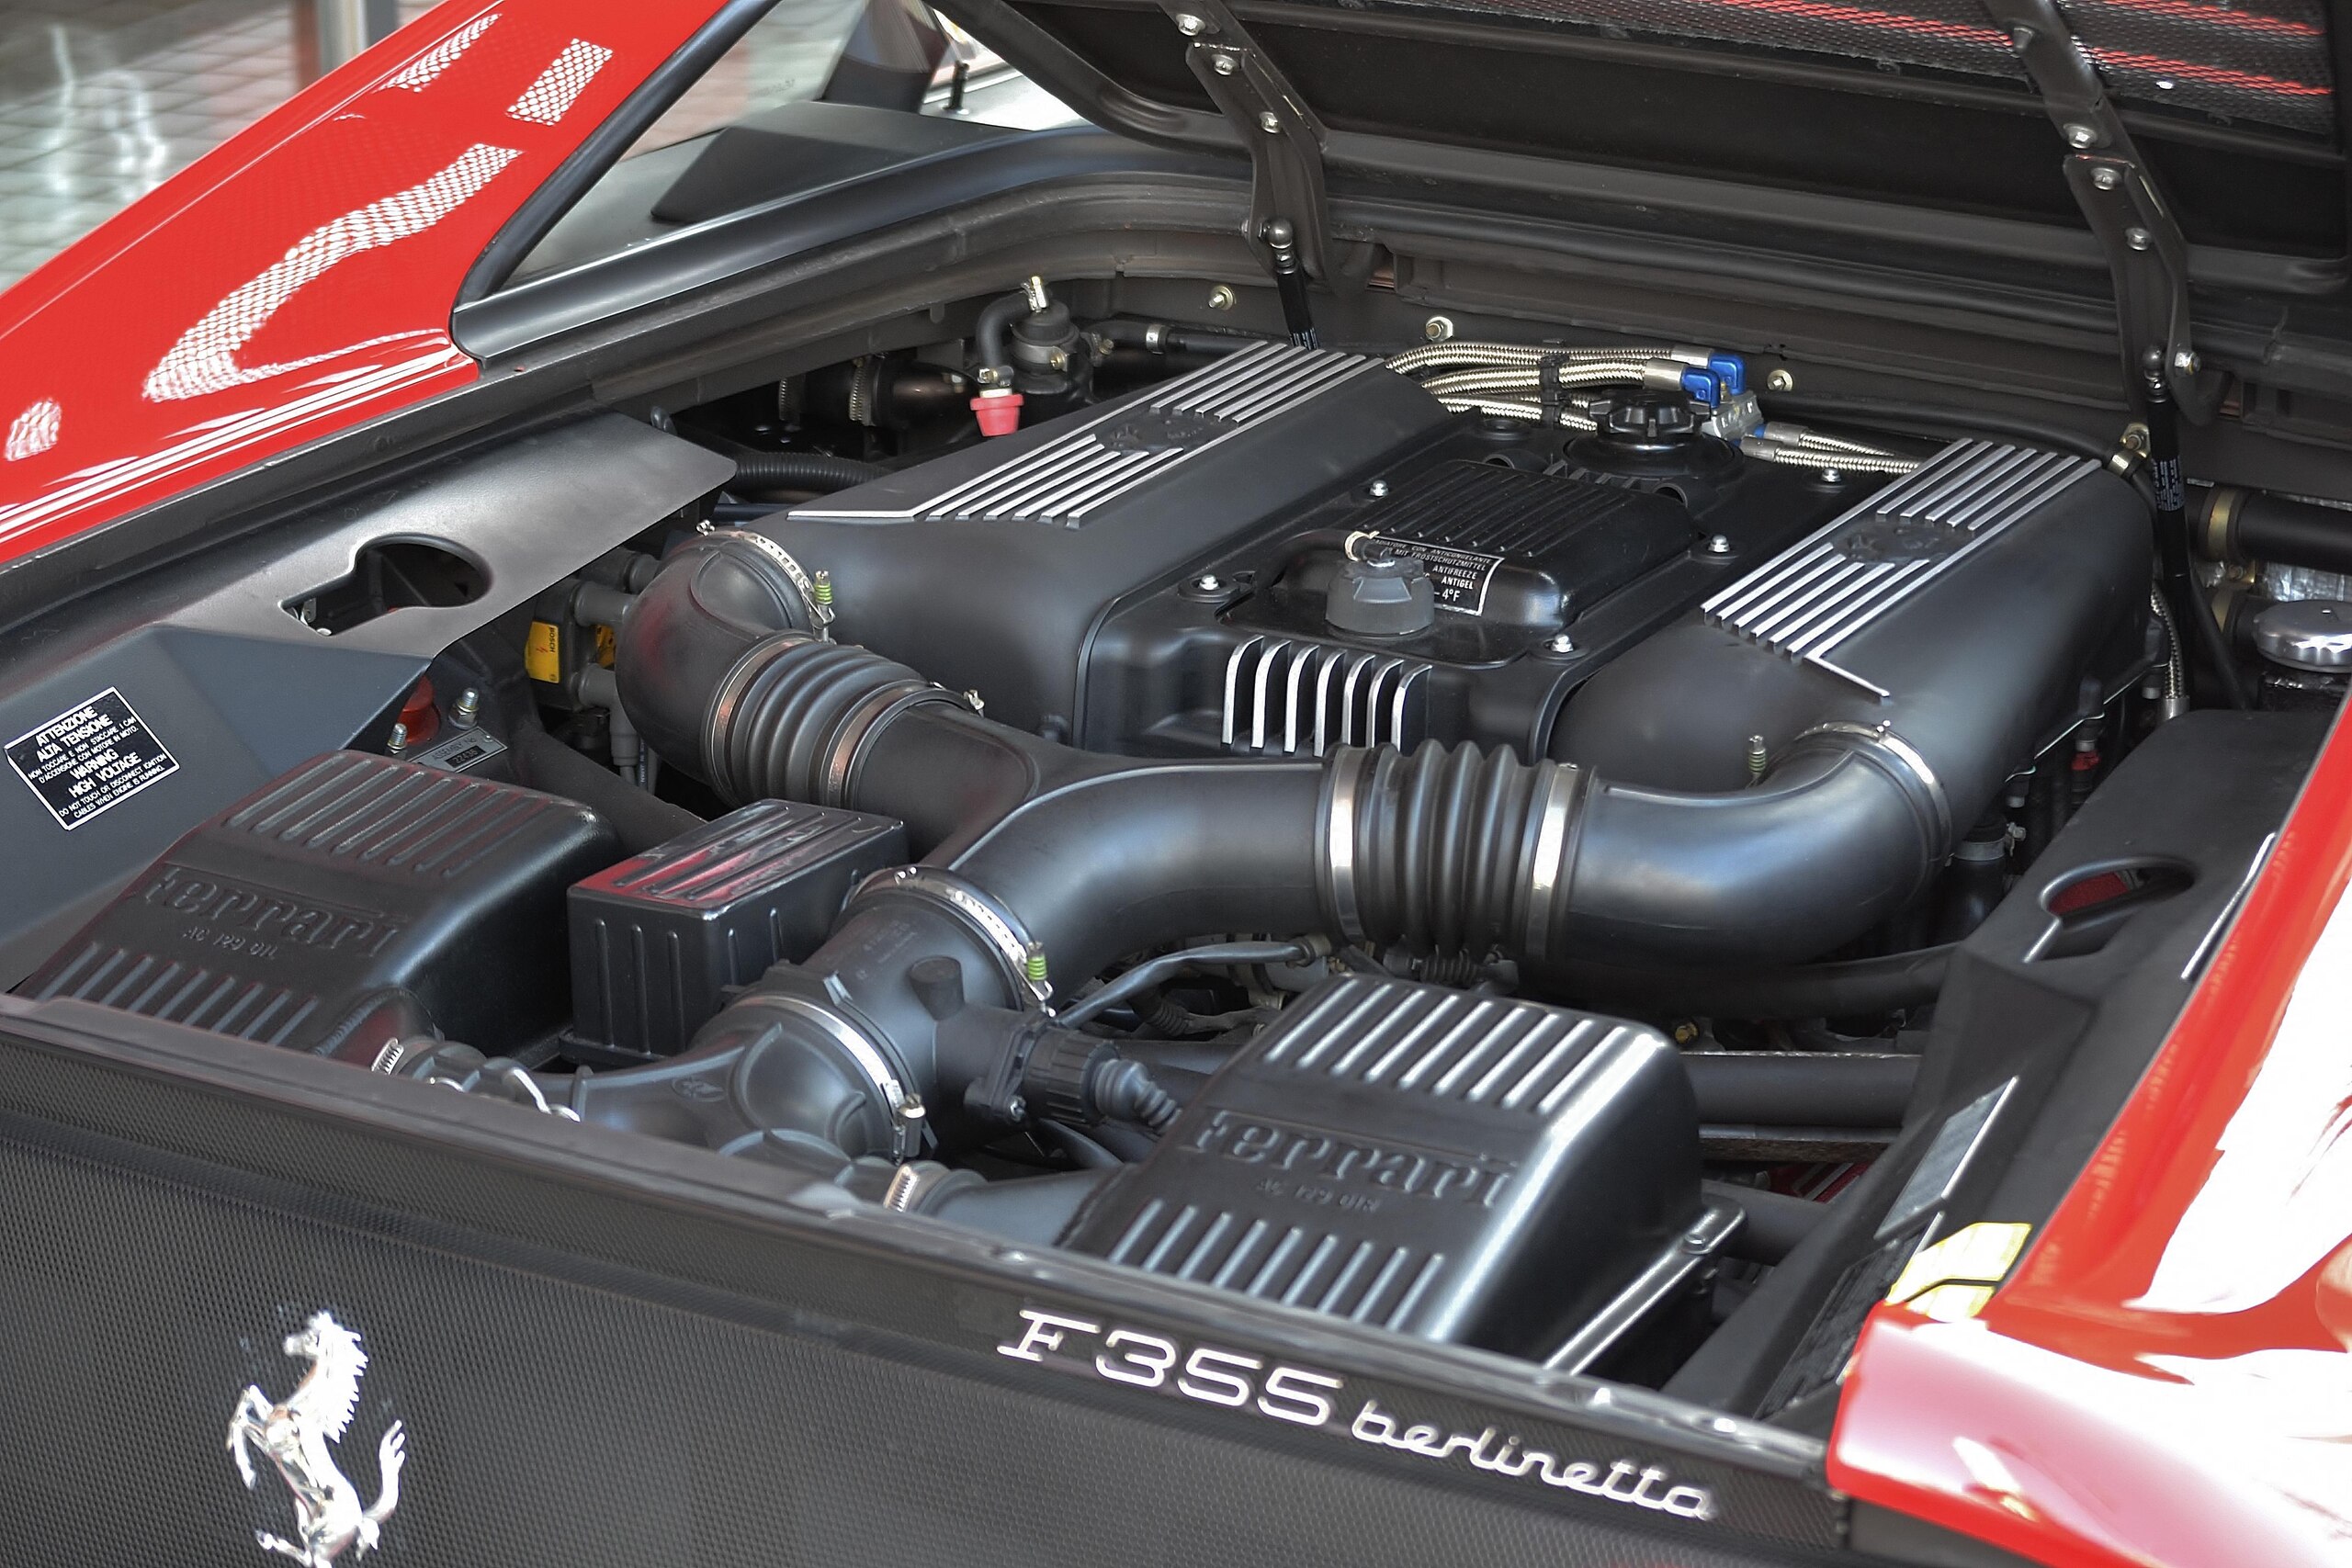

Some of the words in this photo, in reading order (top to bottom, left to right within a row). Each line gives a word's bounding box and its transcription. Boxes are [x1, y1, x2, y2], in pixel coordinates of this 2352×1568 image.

[1395, 548, 1408, 557] MIT
[1411, 551, 1486, 571] FROSTSCHUTZMITTEL
[1430, 548, 1493, 564] ANTICONGELANTE
[1432, 565, 1477, 580] ANTIFREEZE
[1441, 576, 1474, 590] ANTIGEL
[36, 705, 98, 747] ATTENZIONE
[37, 742, 63, 763] ALTA
[60, 714, 113, 747] TENSIONE
[28, 768, 43, 781] NON
[41, 754, 69, 773] TOCCARE
[74, 742, 90, 754] NON
[70, 749, 119, 780] WARNING
[77, 750, 92, 761] CON
[69, 777, 96, 798] HIGH
[96, 751, 142, 782] VOLTAGE
[59, 808, 70, 818] DO
[68, 801, 82, 812] NOT
[80, 790, 101, 805] TOUCH
[74, 802, 96, 818] CABLES
[144, 862, 408, 957] Ferrari
[1180, 1110, 1520, 1208] Ferrari
[1351, 1399, 1717, 1521] berlinetta
